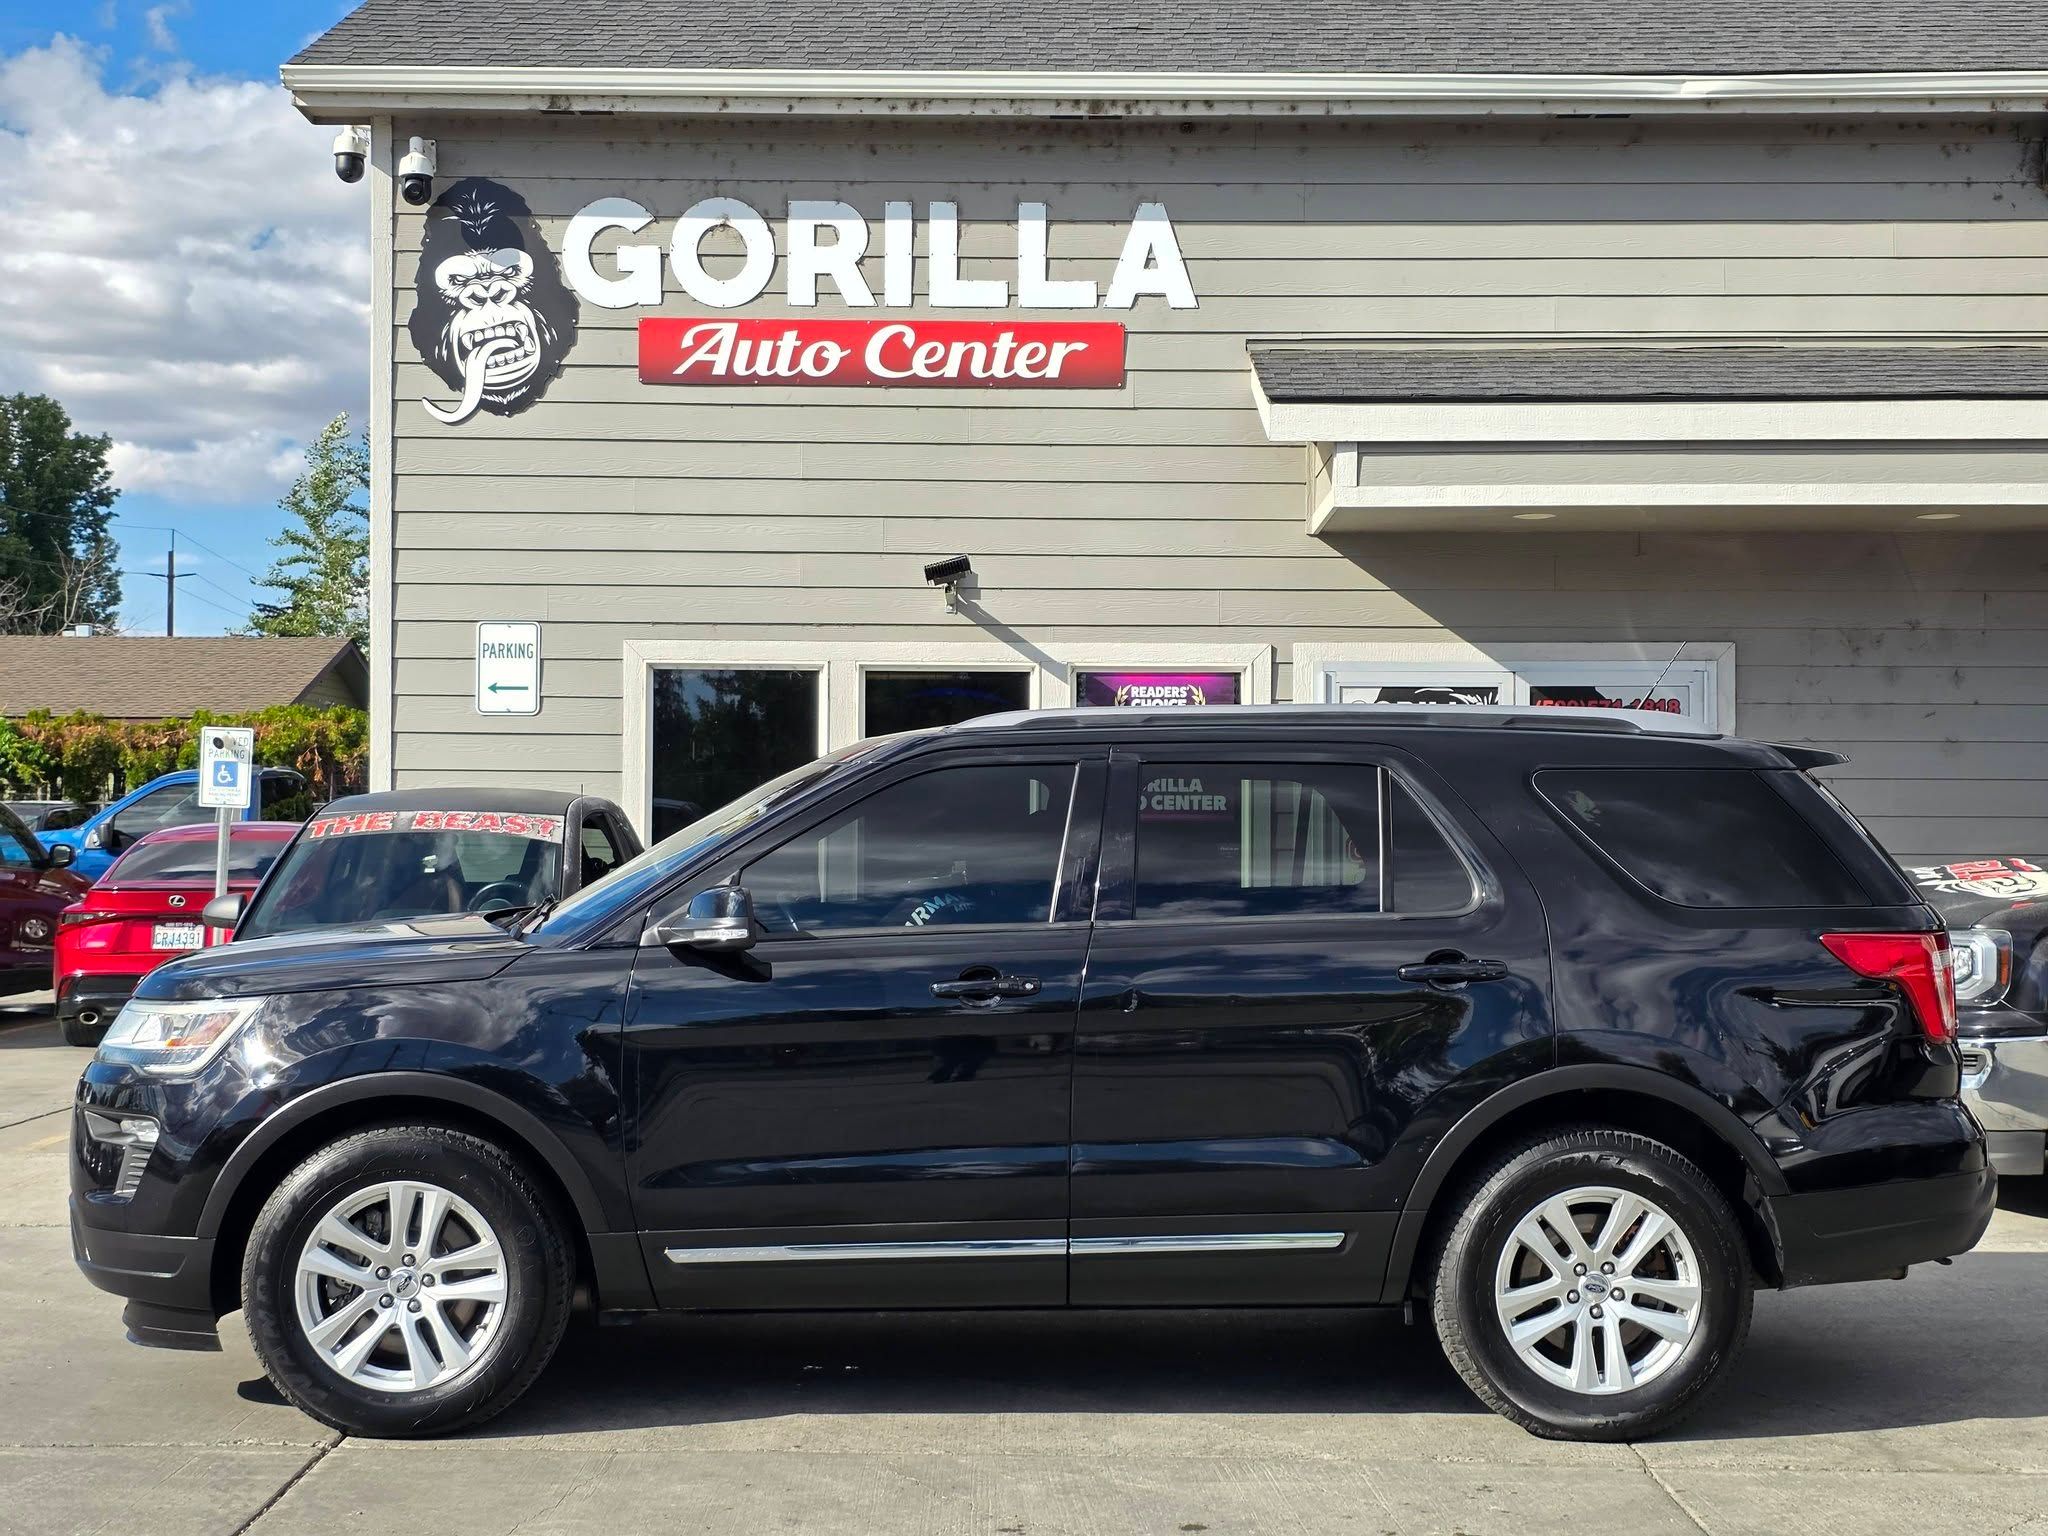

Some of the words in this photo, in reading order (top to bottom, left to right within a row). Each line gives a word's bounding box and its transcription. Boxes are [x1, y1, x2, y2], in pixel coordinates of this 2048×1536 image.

[561, 197, 1199, 310] GORILLA
[672, 322, 852, 380] Auto
[864, 323, 1088, 380] Center
[482, 643, 534, 659] PARKING
[1131, 685, 1190, 698] READERS'
[208, 748, 245, 760] PARKING
[1143, 778, 1203, 792] RILLA
[1150, 794, 1227, 811] CENTER
[308, 811, 397, 838] THE
[411, 811, 562, 837] BEAST
